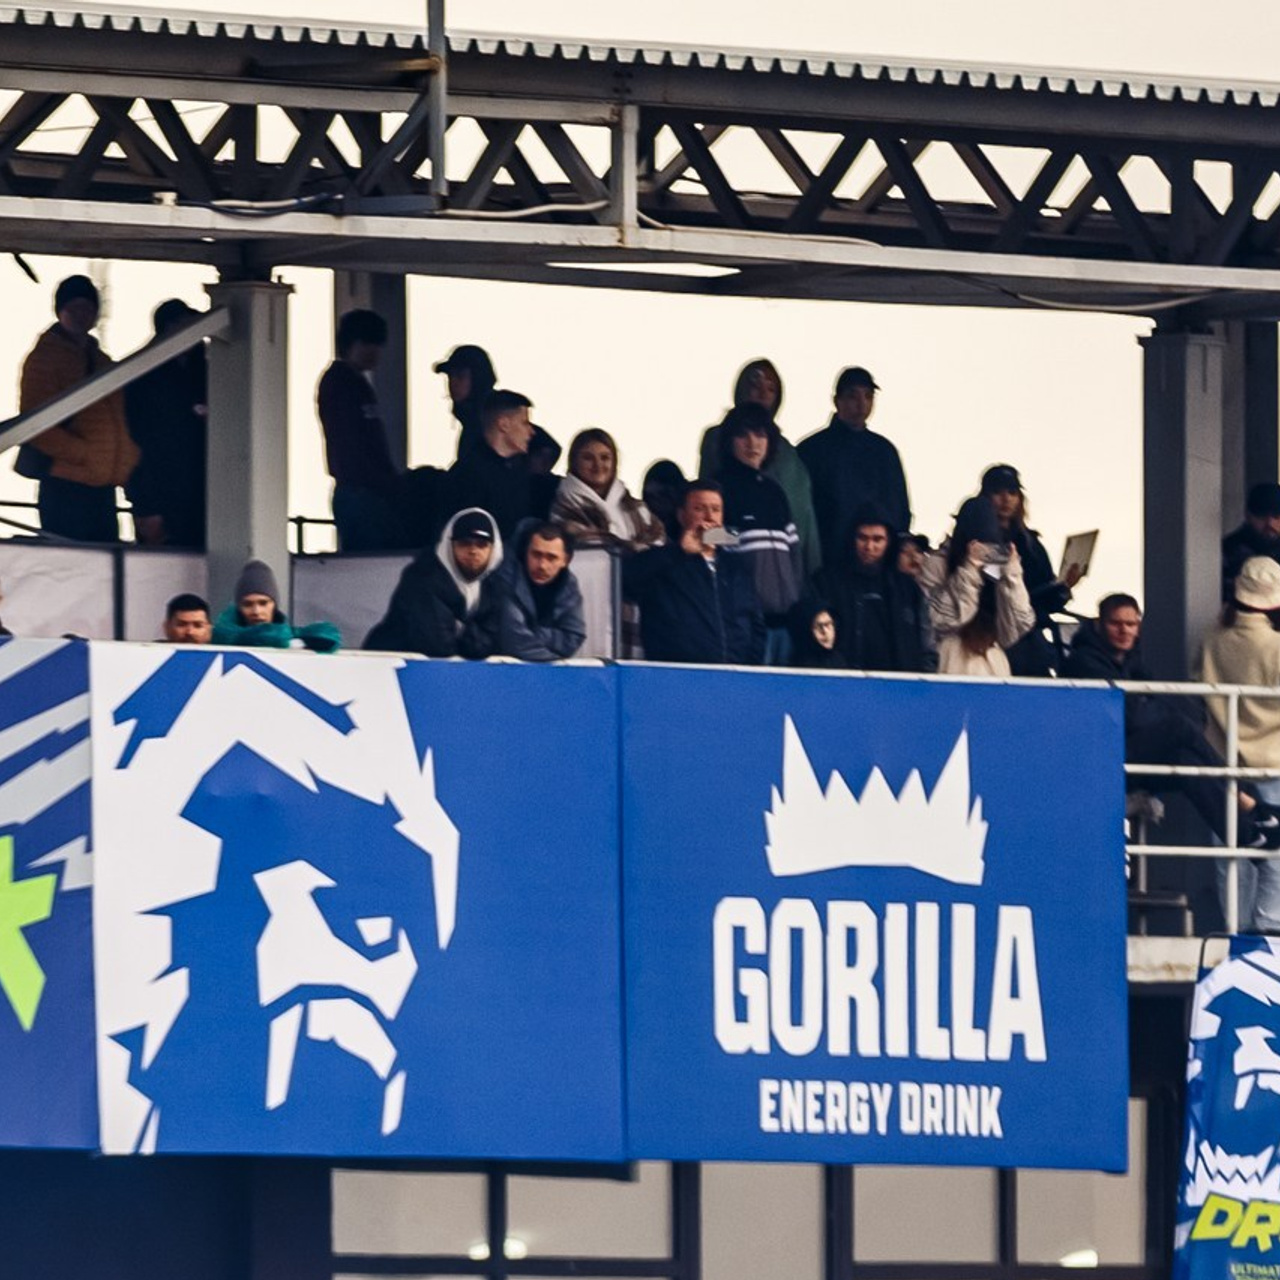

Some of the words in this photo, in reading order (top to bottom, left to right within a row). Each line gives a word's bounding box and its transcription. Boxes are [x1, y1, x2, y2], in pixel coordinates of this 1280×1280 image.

[713, 895, 1048, 1062] GORILLA
[759, 1078, 893, 1136] ENERGY
[899, 1081, 1004, 1139] DRINK
[1190, 1193, 1280, 1253] DR
[1230, 1261, 1280, 1280] ULTIMAT
